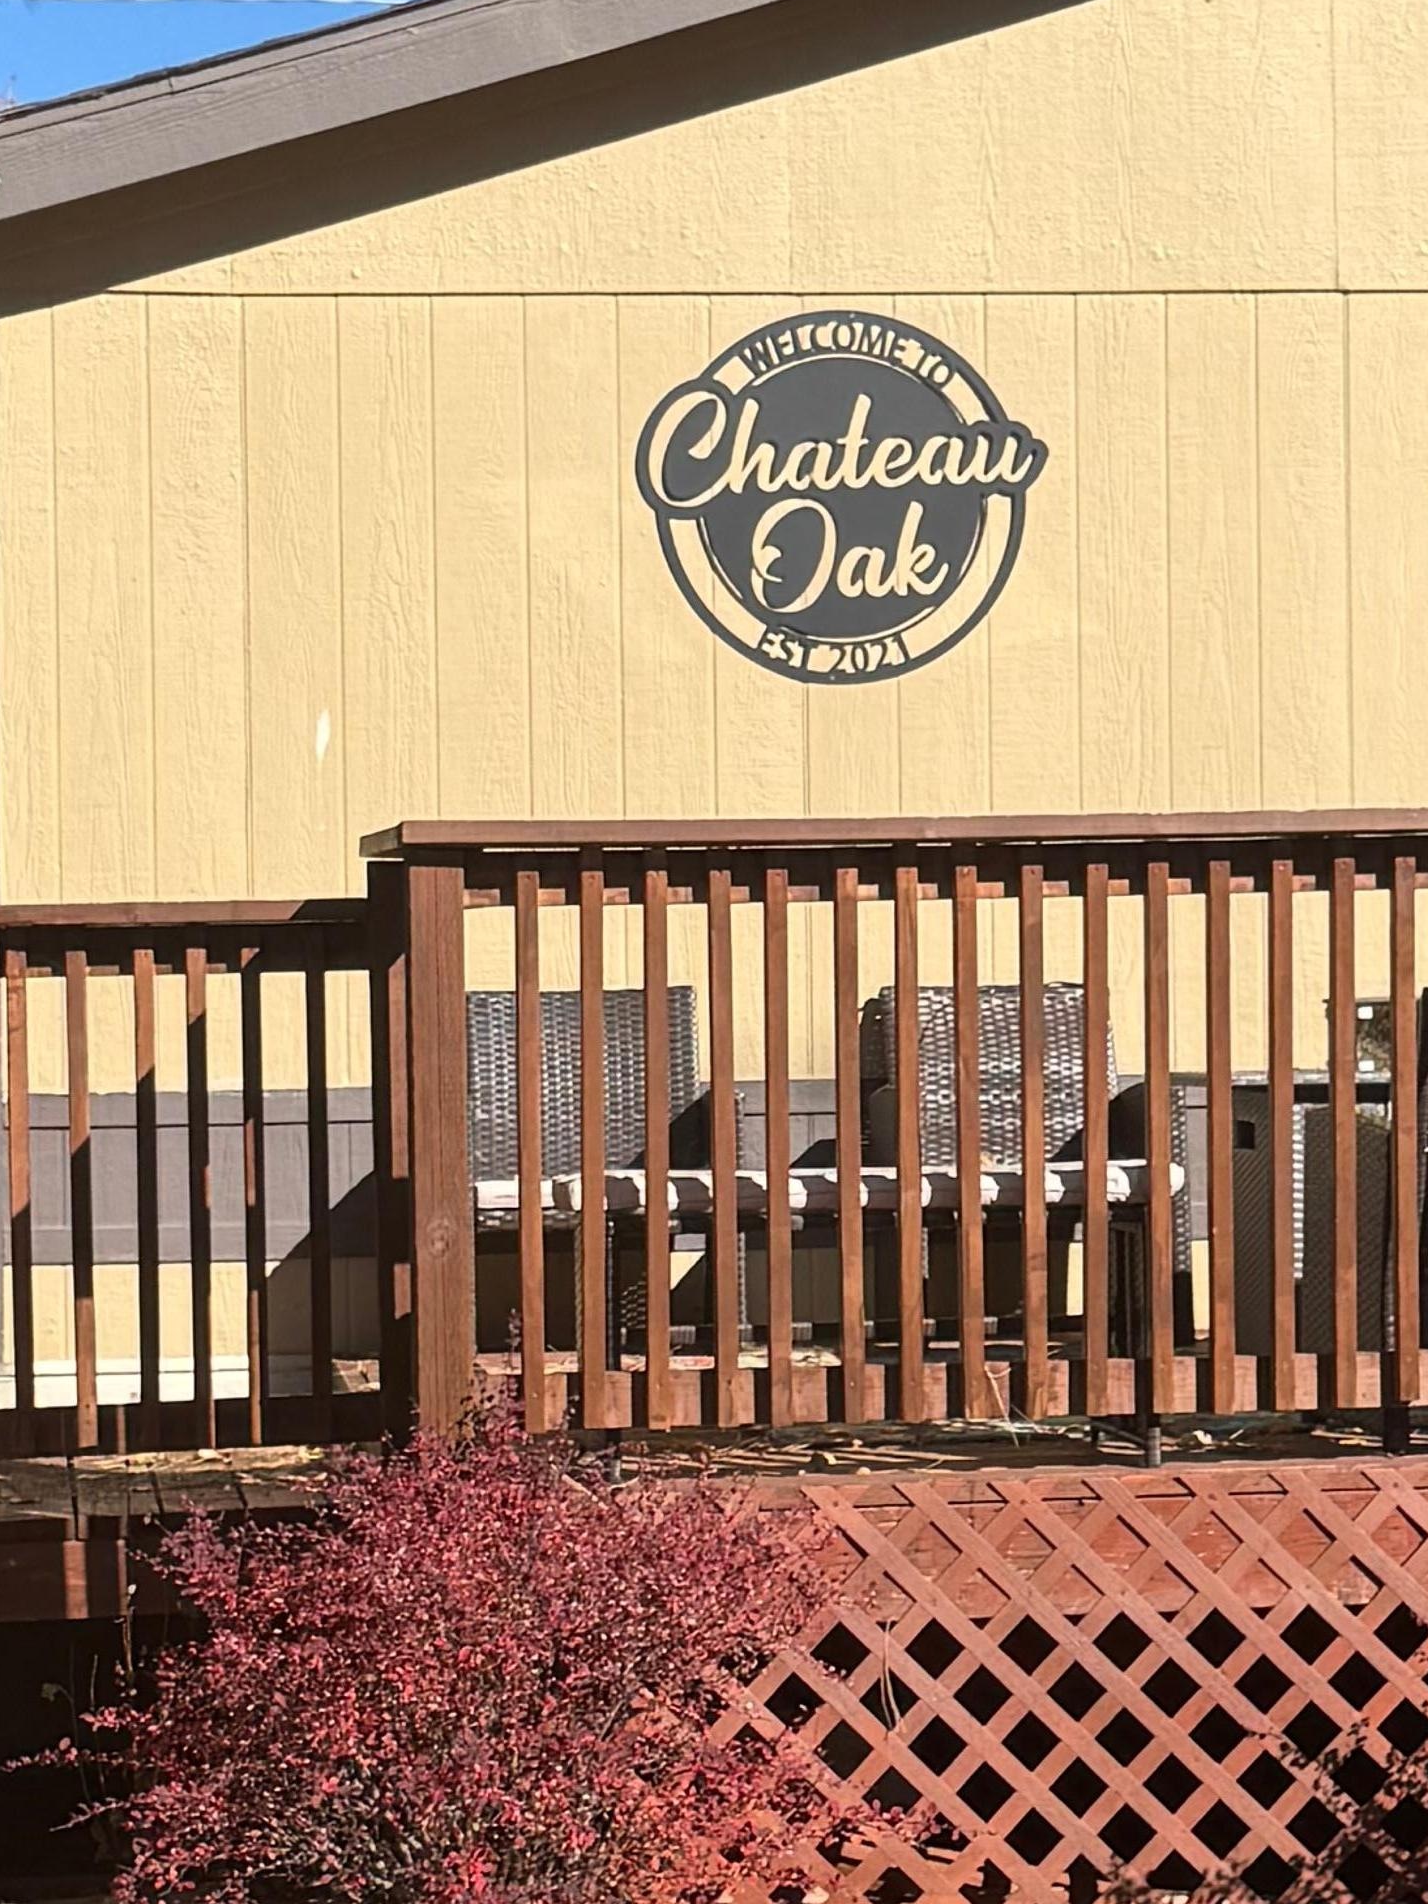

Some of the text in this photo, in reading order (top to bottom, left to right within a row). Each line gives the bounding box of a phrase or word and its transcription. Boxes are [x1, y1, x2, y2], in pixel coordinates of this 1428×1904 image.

[738, 319, 956, 388] WELCOME TO
[648, 391, 1035, 508] Chateau
[750, 498, 950, 614] Oak
[757, 629, 911, 674] EST 2021
